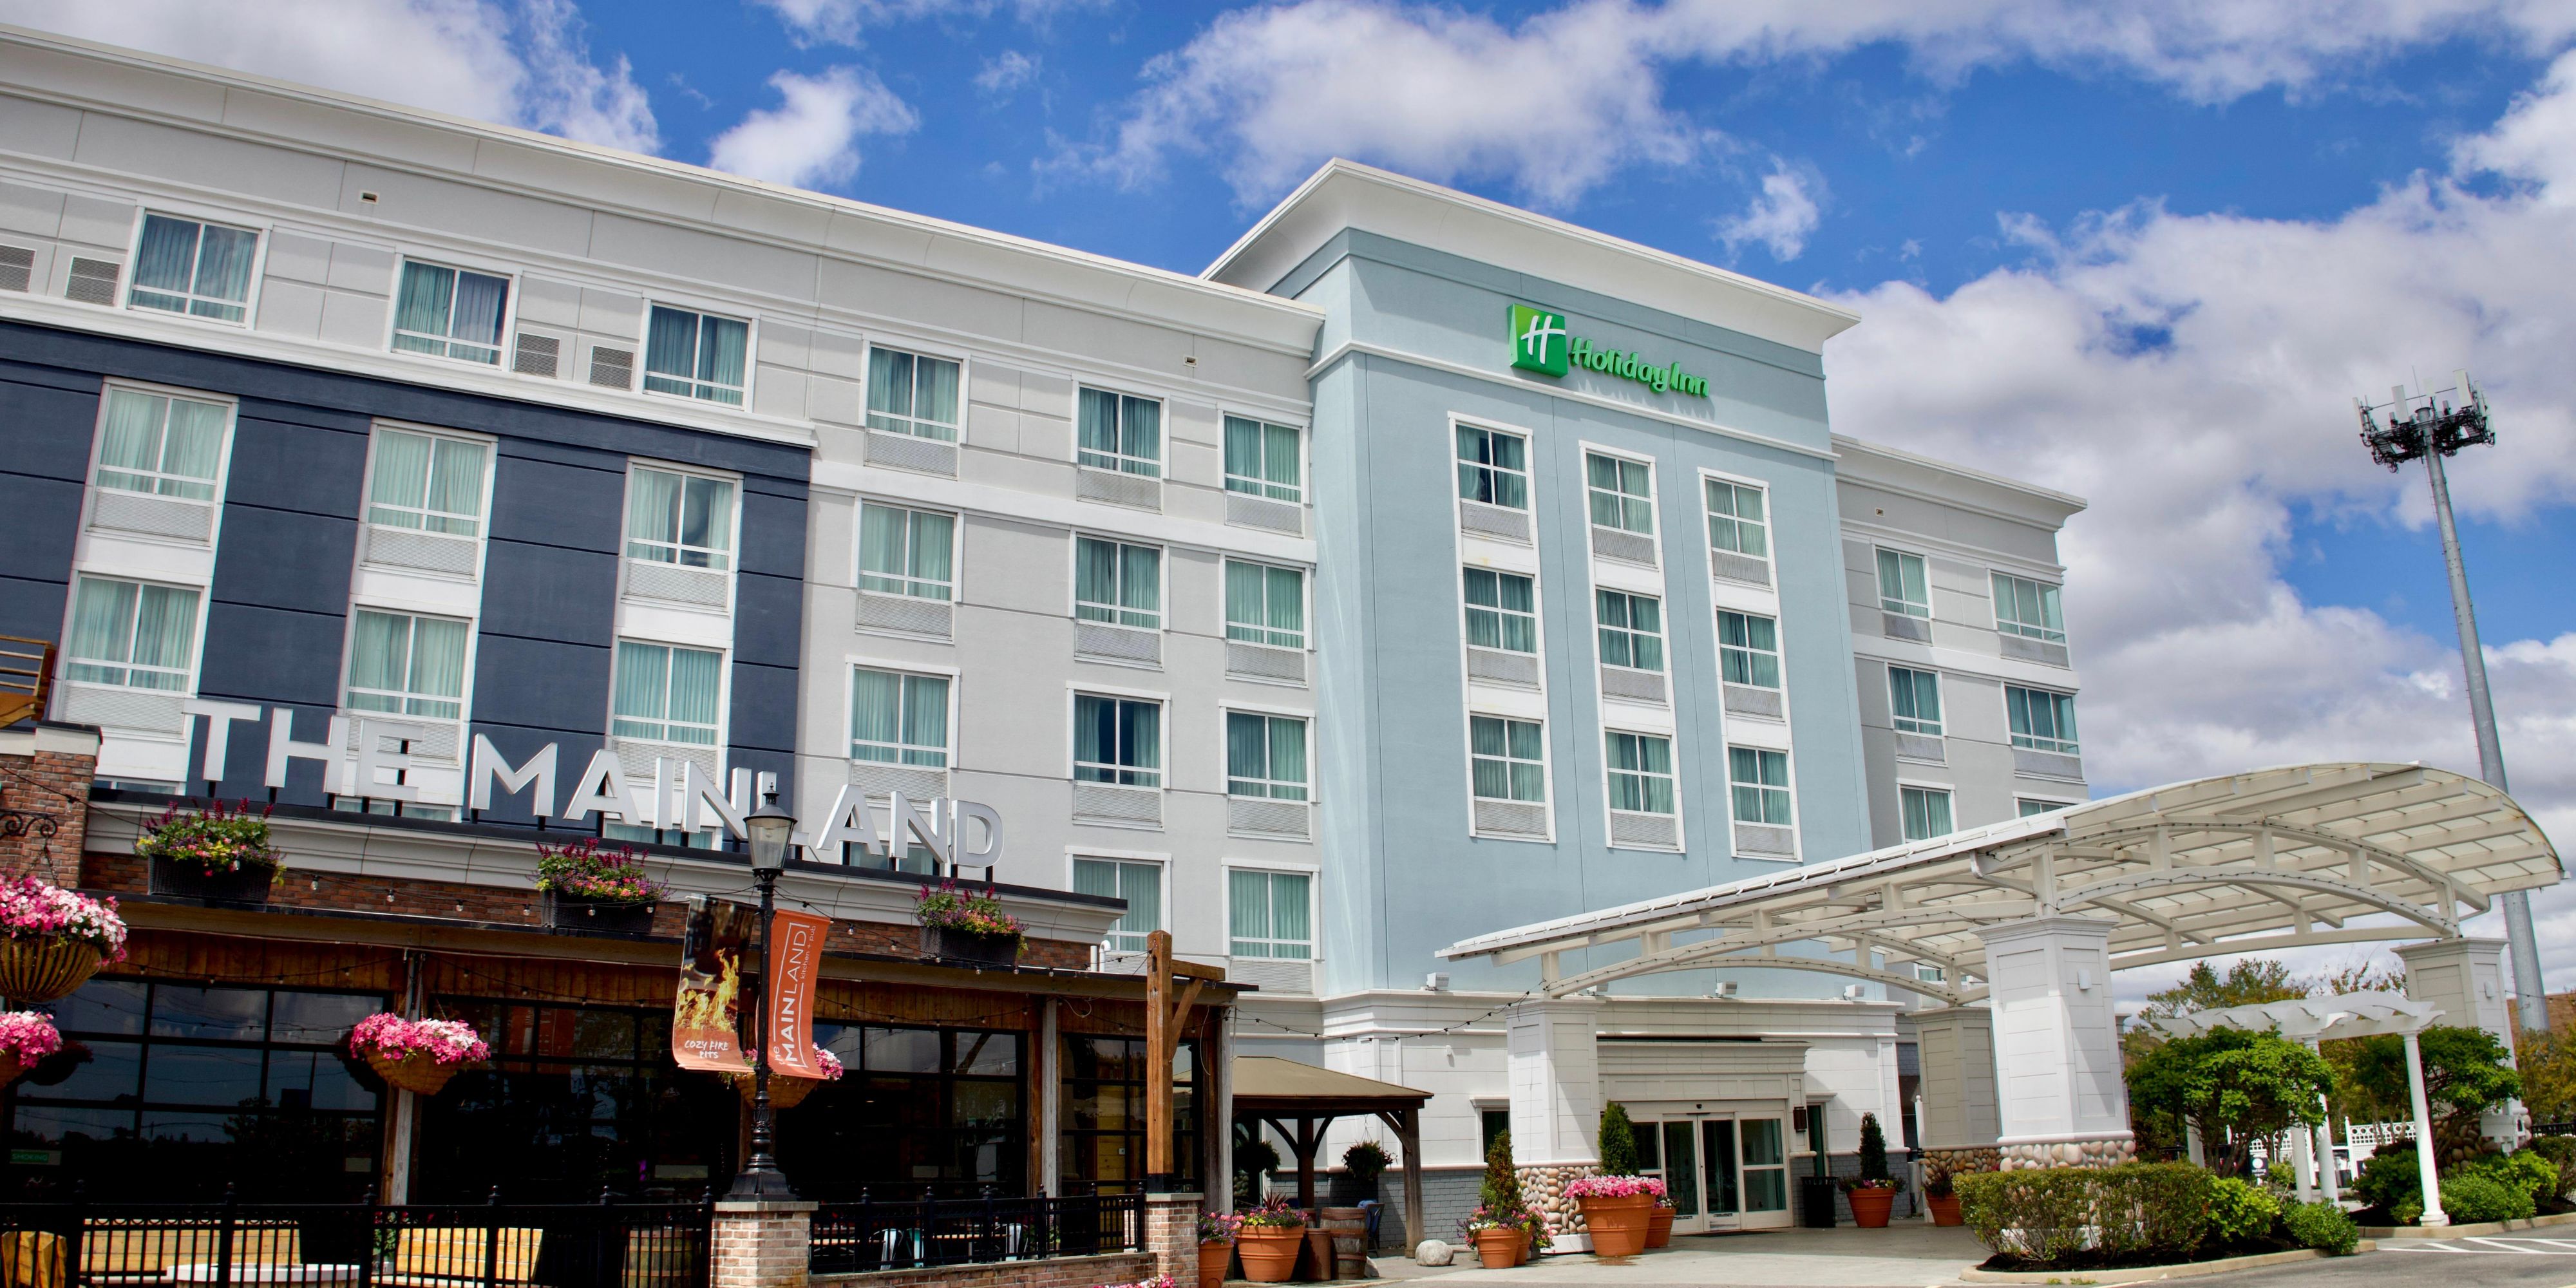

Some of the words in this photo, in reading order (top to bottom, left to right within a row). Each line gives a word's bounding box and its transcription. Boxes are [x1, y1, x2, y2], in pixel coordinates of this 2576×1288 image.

[1569, 336, 1670, 392] Holiday
[1670, 361, 1709, 397] Inn
[182, 697, 424, 802] THE
[470, 733, 1005, 868] MAINLAND
[800, 951, 810, 979] kitchen
[781, 931, 806, 1062] MAINLAND
[685, 1039, 707, 1050] COZY
[710, 1041, 729, 1051] FIRE
[699, 1050, 719, 1059] PITS
